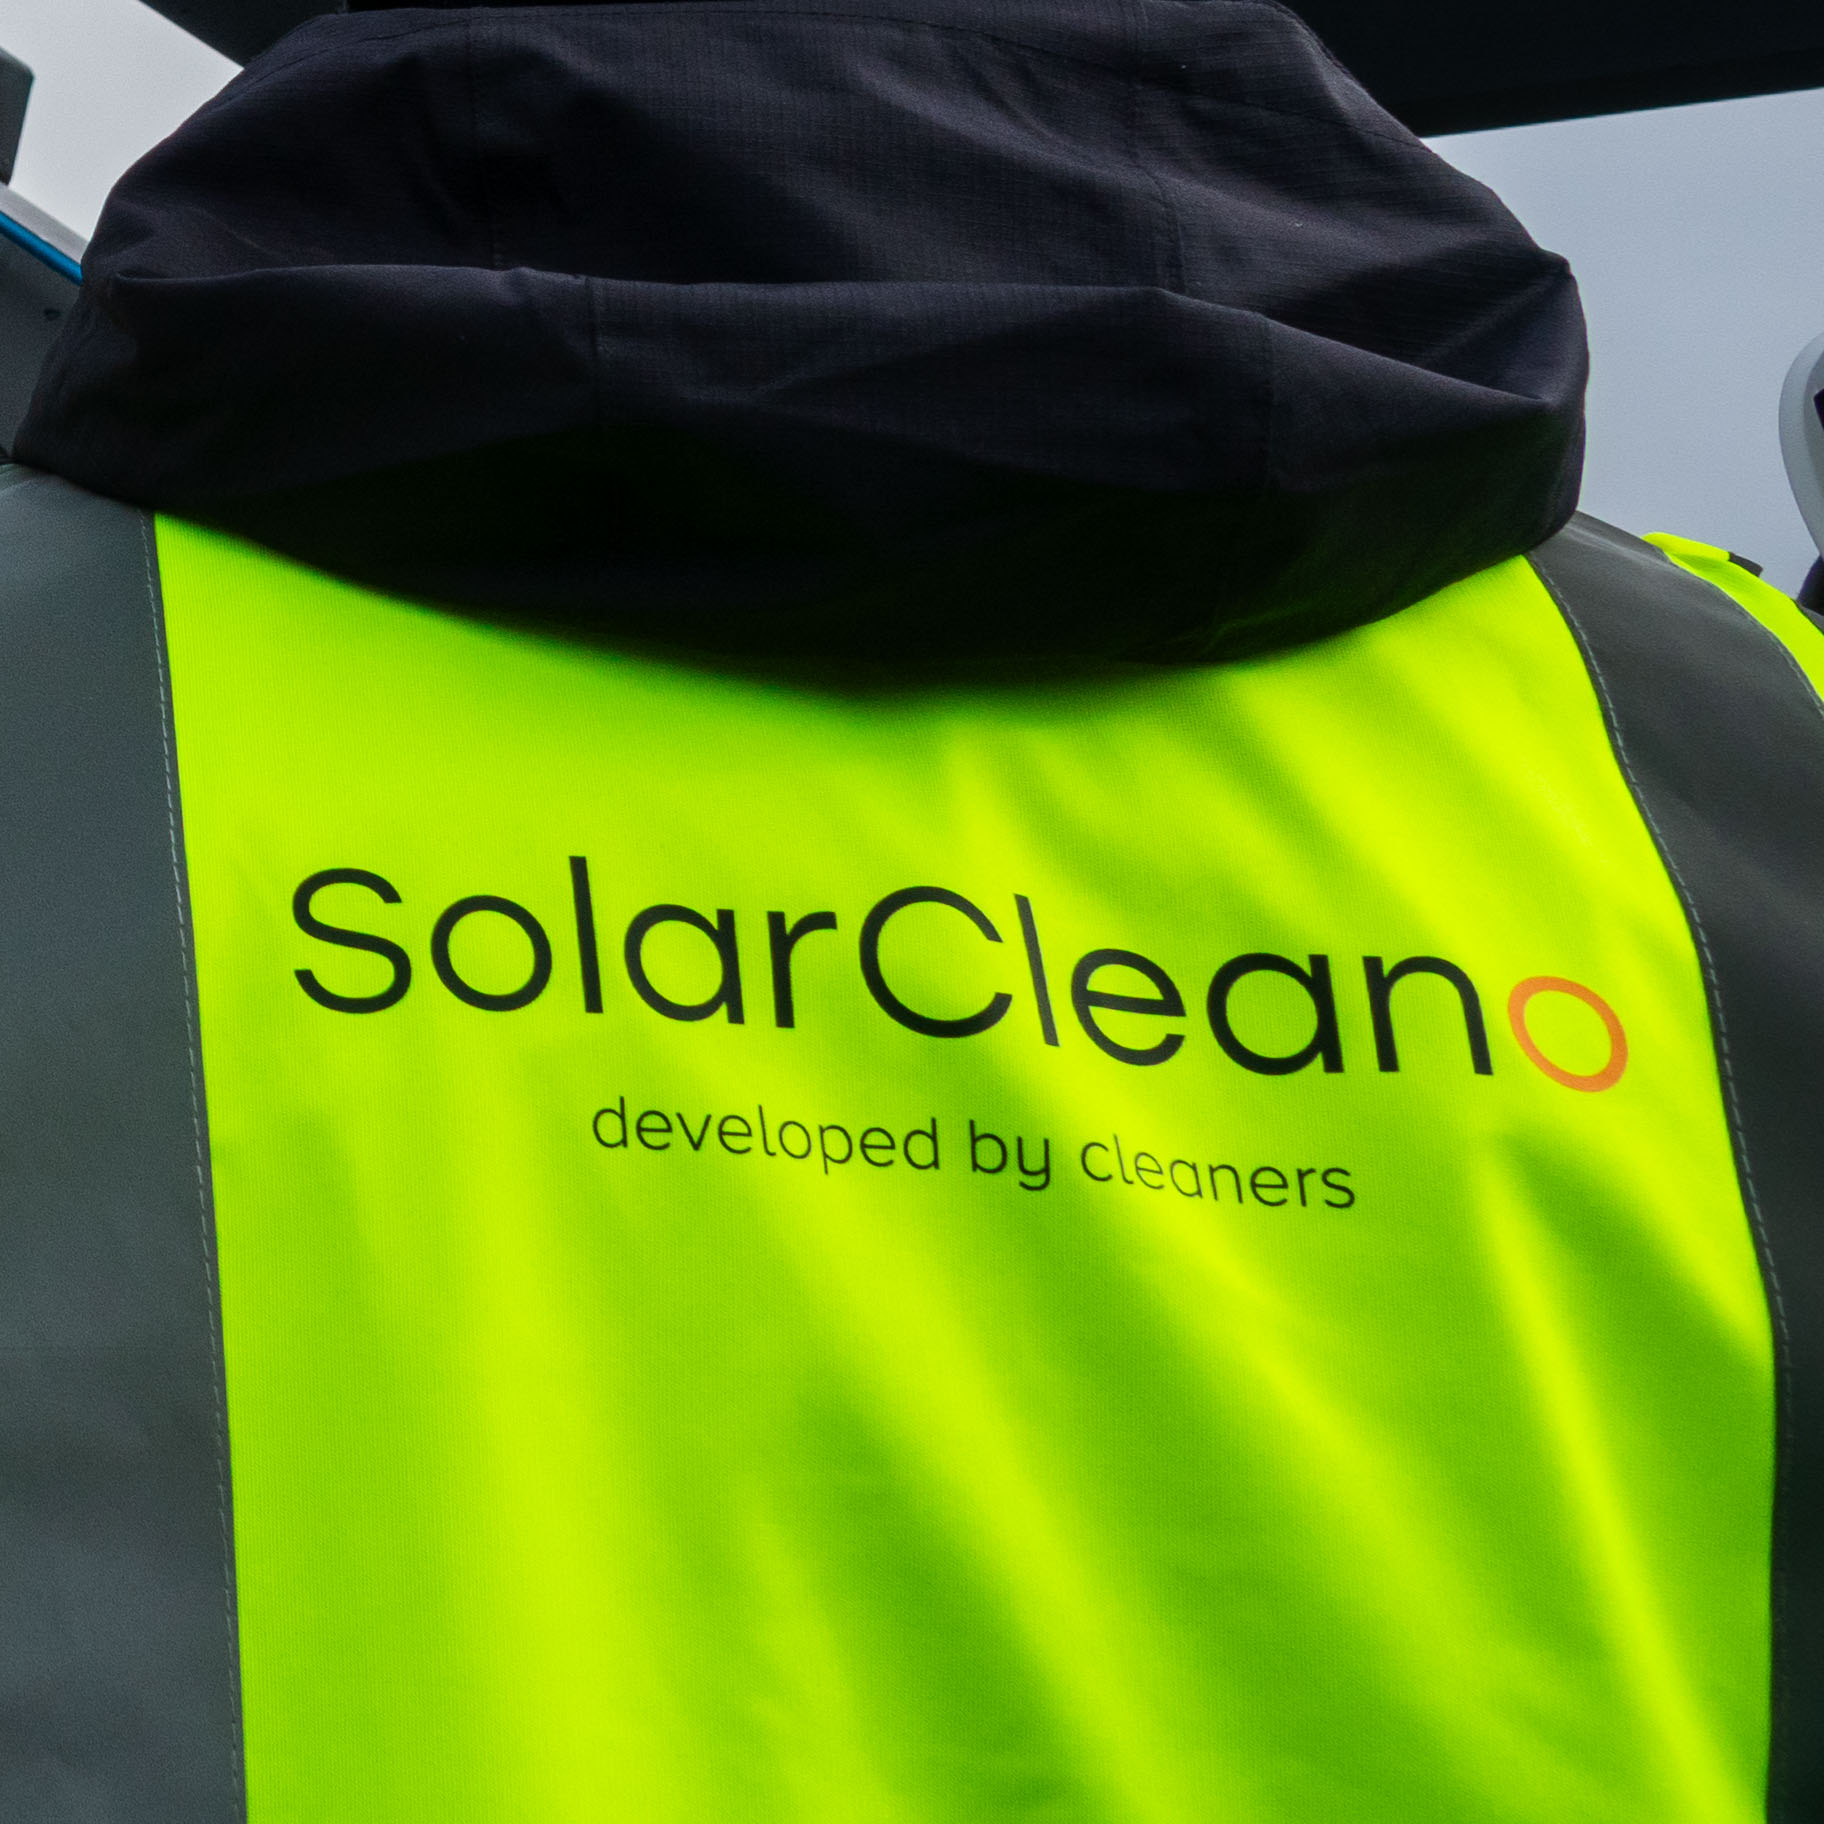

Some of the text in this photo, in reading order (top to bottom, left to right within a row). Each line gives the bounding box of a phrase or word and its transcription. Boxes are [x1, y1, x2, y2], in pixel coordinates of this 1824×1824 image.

[290, 855, 1631, 1095] SolarCleano
[591, 1096, 1357, 1212] developed by cleaners
